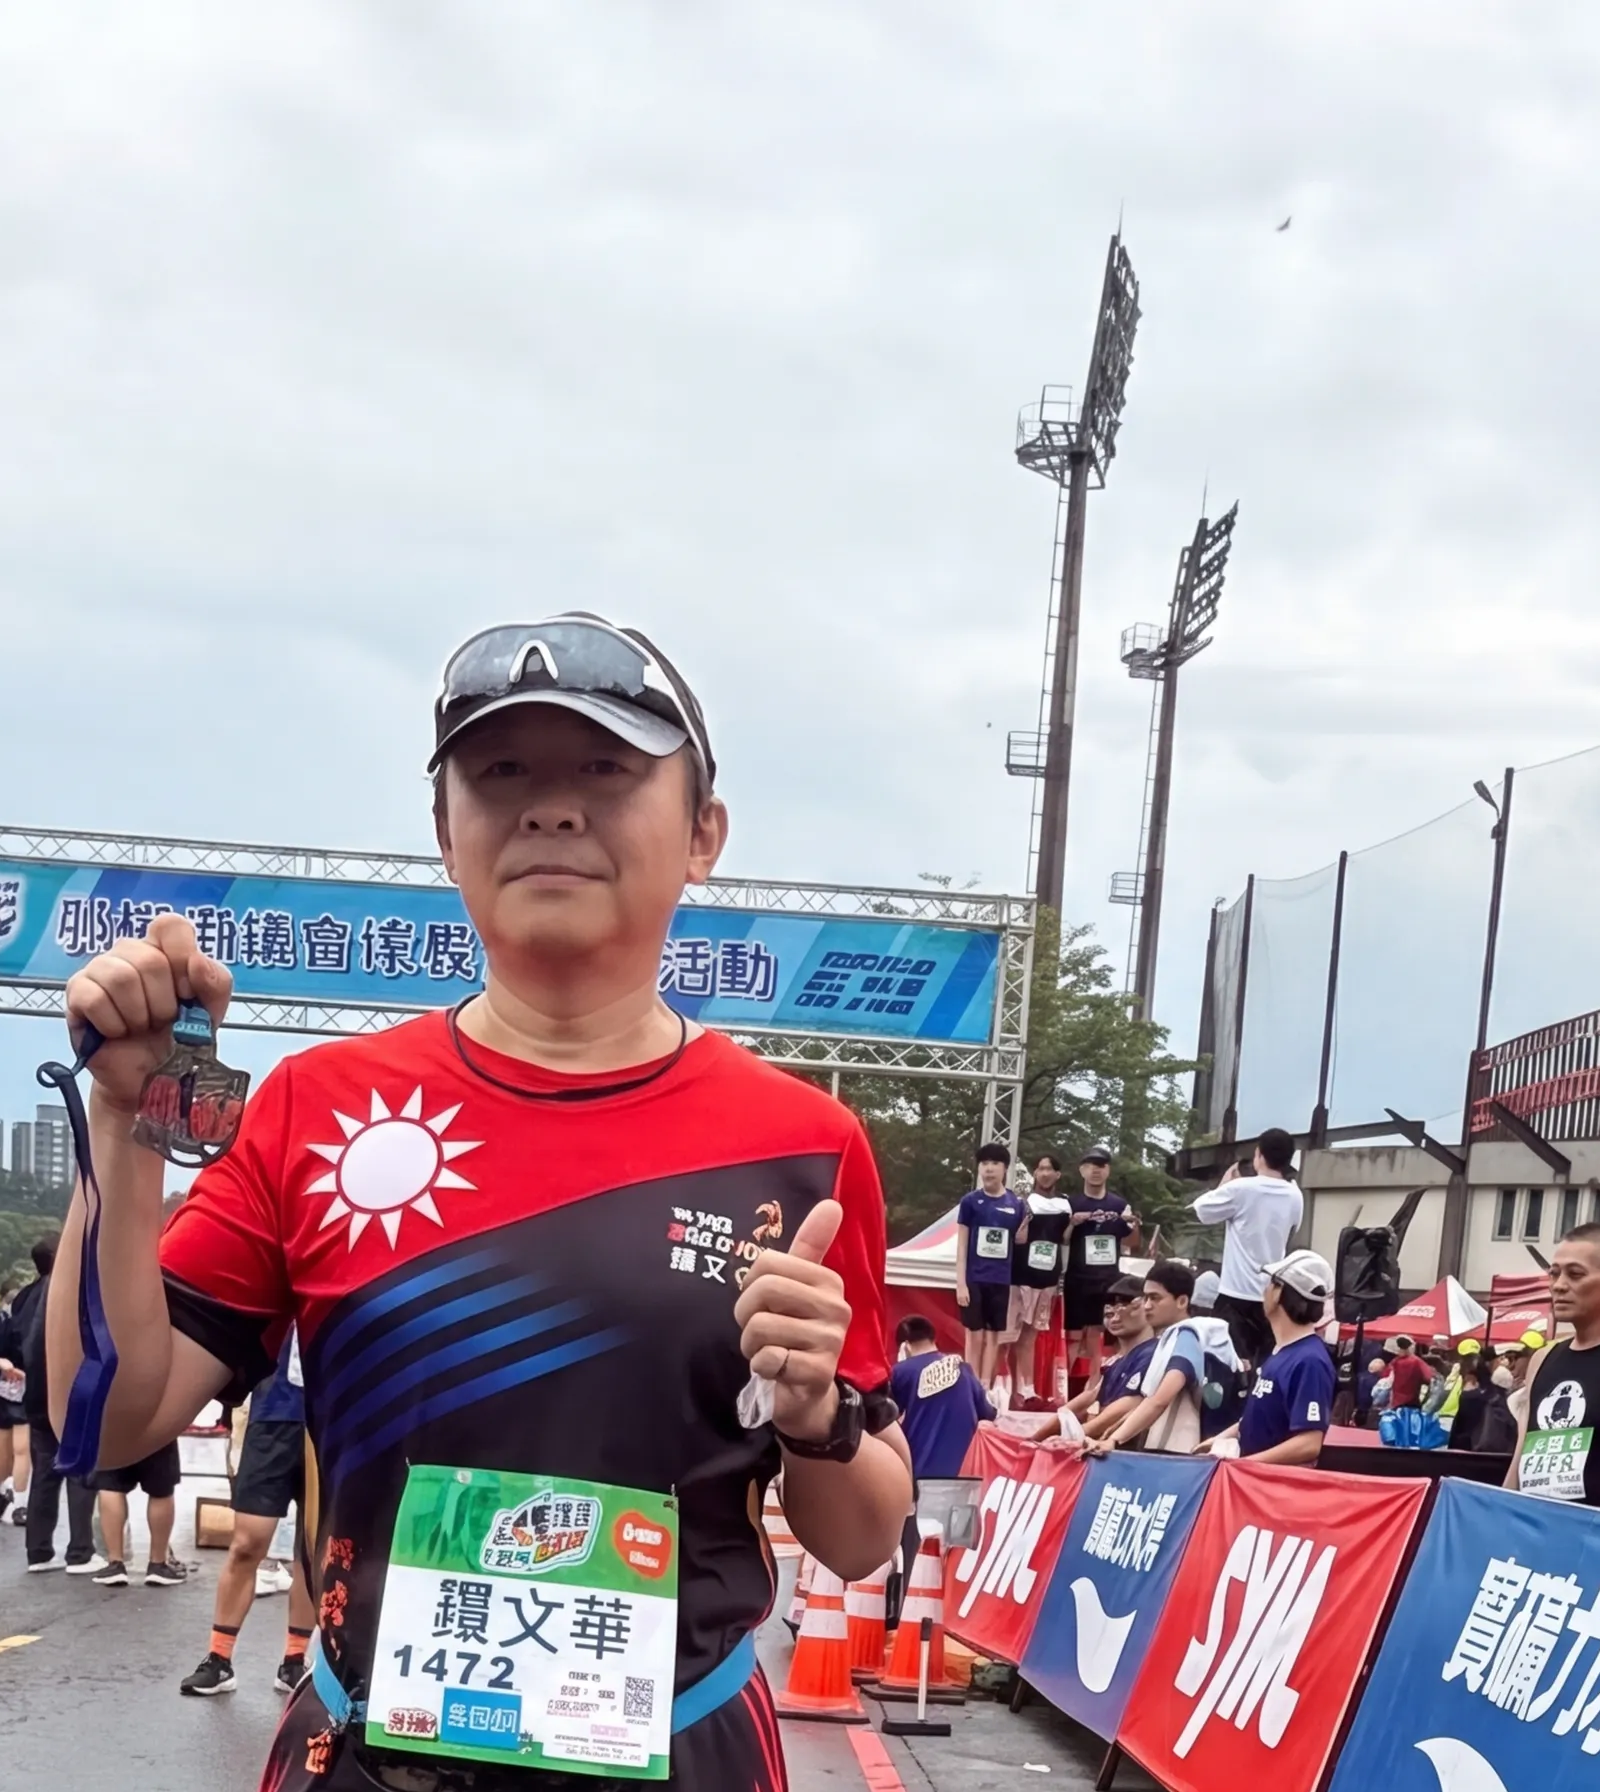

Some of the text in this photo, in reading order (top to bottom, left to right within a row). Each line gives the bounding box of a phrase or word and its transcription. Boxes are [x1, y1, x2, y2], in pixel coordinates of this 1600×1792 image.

[955, 1475, 1055, 1618] SYM
[393, 1644, 515, 1690] 1472
[1172, 1524, 1338, 1759] SYM
